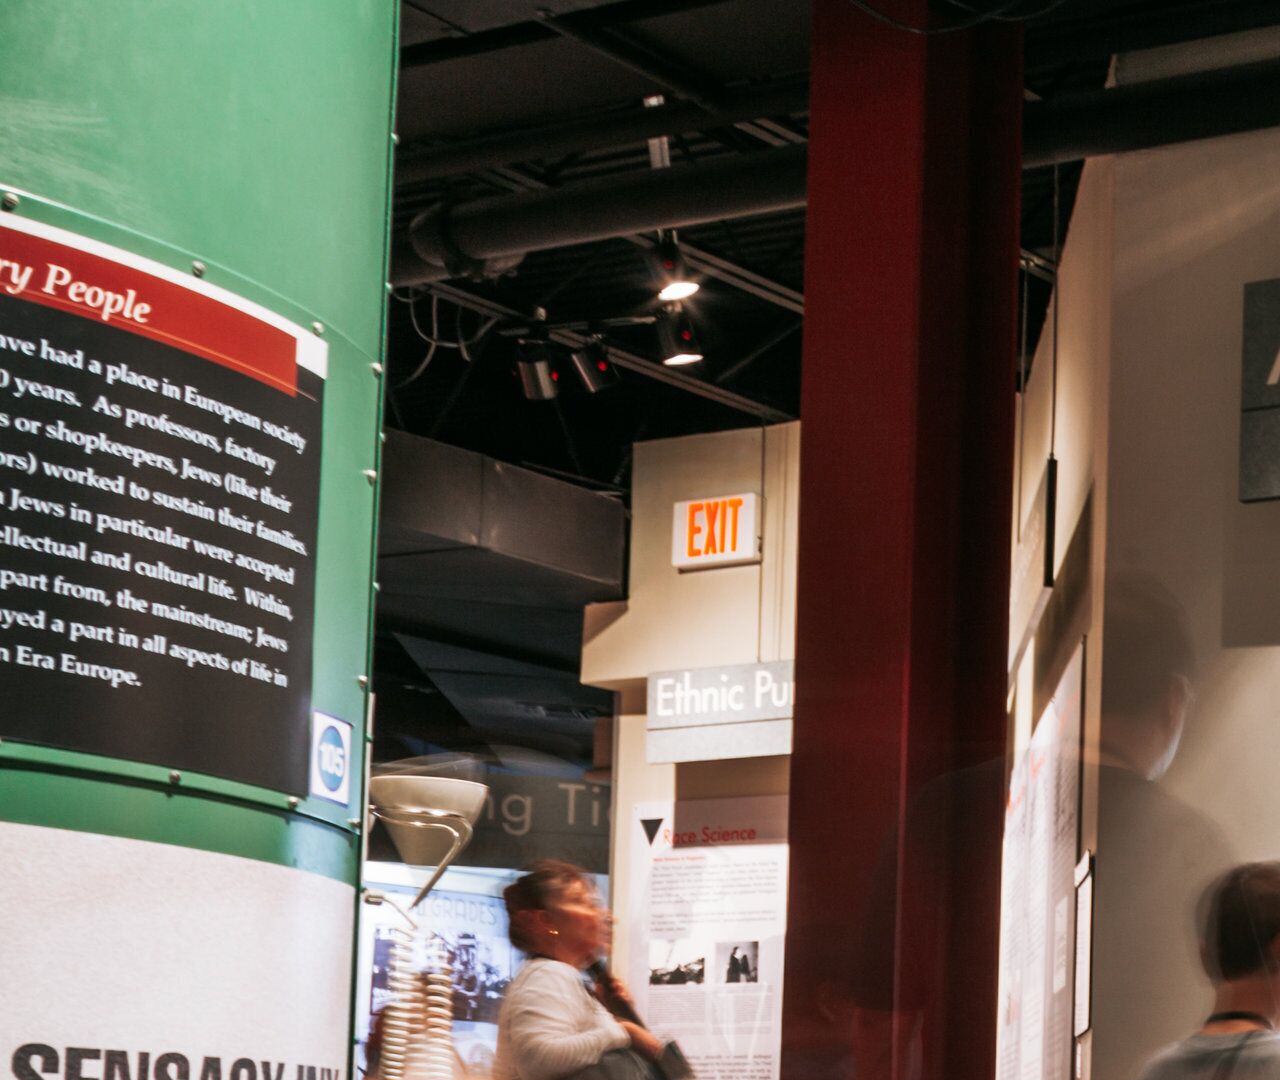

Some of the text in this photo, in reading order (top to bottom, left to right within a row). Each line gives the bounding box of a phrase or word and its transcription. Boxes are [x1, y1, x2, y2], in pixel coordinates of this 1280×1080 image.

[42, 264, 152, 323] People
[13, 376, 277, 476] years. As professors, factory
[40, 339, 307, 454] had a place in European society
[15, 417, 293, 514] or shopkeepers, Jews (like their
[8, 488, 295, 585] Jews in particular were accepted
[43, 461, 308, 556] worked to sustain their families.
[688, 497, 741, 557] EXIT
[54, 575, 112, 607] from,
[116, 589, 148, 614] the
[151, 601, 254, 643] mainstream;
[255, 627, 288, 653] Jews
[90, 549, 131, 572] and
[134, 560, 205, 592] cultural
[208, 573, 238, 601] life.
[245, 587, 294, 621] Within,
[15, 645, 142, 688] Era Europe.
[51, 619, 288, 688] a part in all aspects of life in
[656, 672, 744, 716] Ethnic
[319, 742, 344, 777] 105
[663, 826, 756, 845] Race Science
